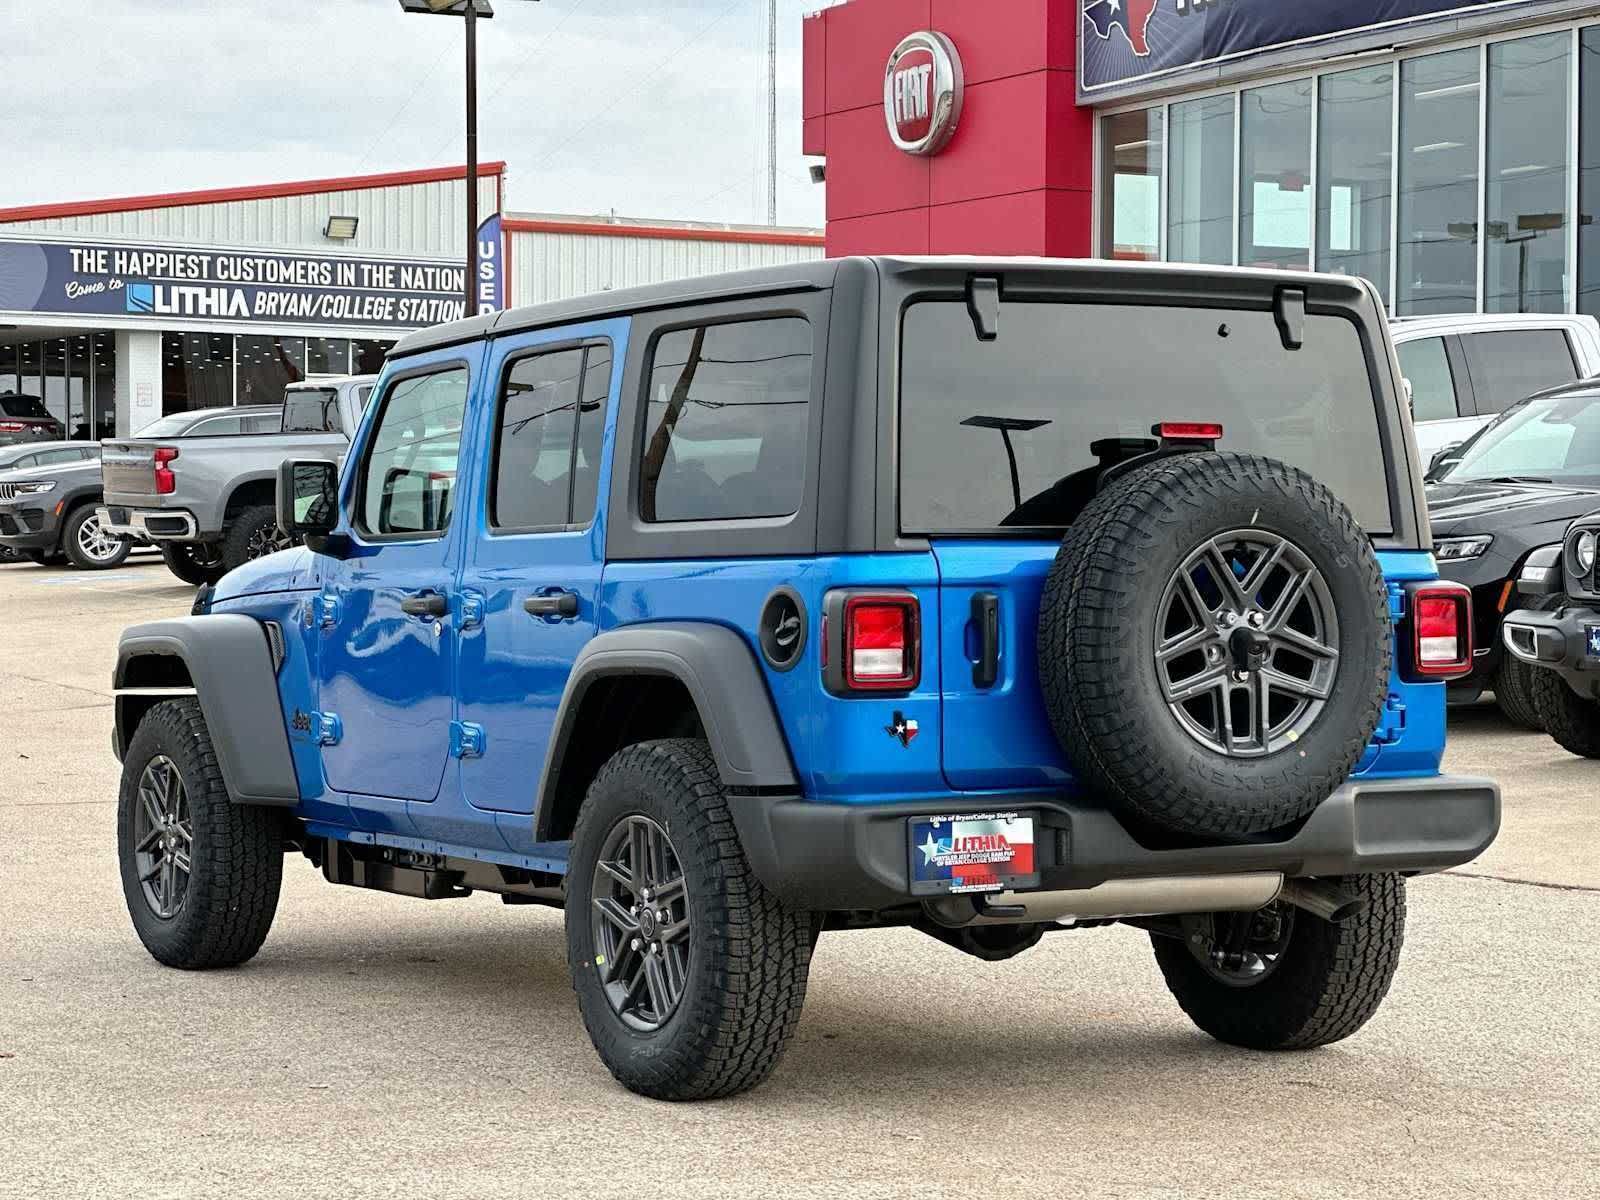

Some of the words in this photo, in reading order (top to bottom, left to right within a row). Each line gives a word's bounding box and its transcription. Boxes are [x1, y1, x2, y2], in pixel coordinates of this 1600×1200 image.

[895, 64, 931, 122] FIAT
[70, 249, 108, 273] THE
[114, 250, 211, 279] HAPPIEST
[216, 256, 331, 285] CUSTOMERS
[337, 262, 355, 287] IN
[360, 264, 396, 288] THE
[400, 266, 465, 291] NATION
[479, 241, 495, 316] USED
[65, 280, 105, 299] Come
[109, 278, 124, 290] to
[154, 285, 250, 317] LITHIA
[254, 291, 393, 320] BRYAN/COLLEGE
[397, 298, 466, 322] STATION
[930, 815, 948, 823] Lithia
[996, 811, 1018, 819] Station
[953, 833, 1010, 853] LITHIA
